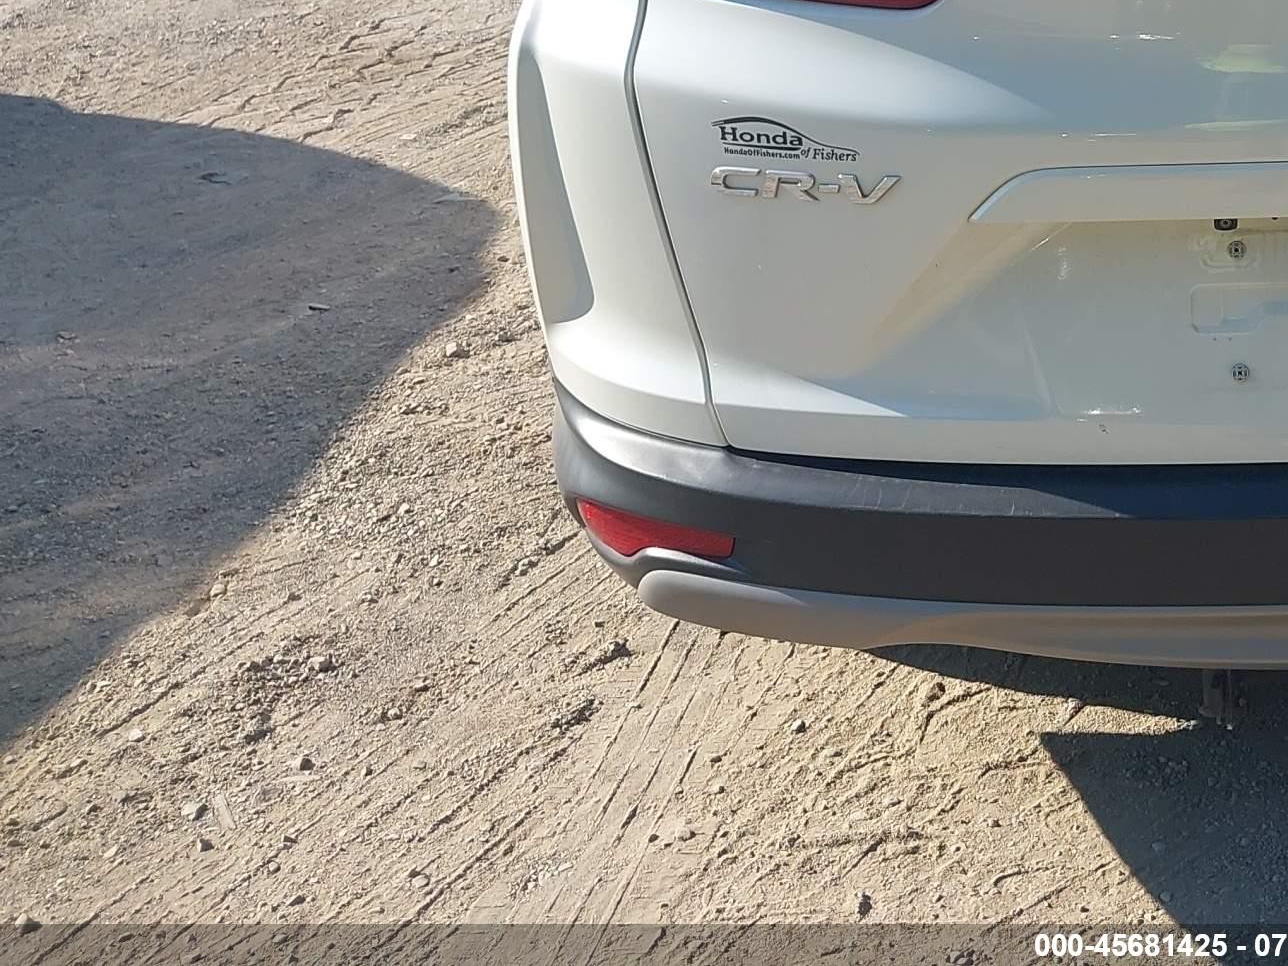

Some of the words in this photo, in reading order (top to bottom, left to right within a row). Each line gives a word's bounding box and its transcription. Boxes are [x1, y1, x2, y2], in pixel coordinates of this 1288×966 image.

[719, 126, 803, 147] Honda
[723, 146, 800, 160] HondaOfFishers.com
[800, 147, 811, 158] of
[812, 148, 857, 162] Fishers
[711, 165, 903, 205] CR-V
